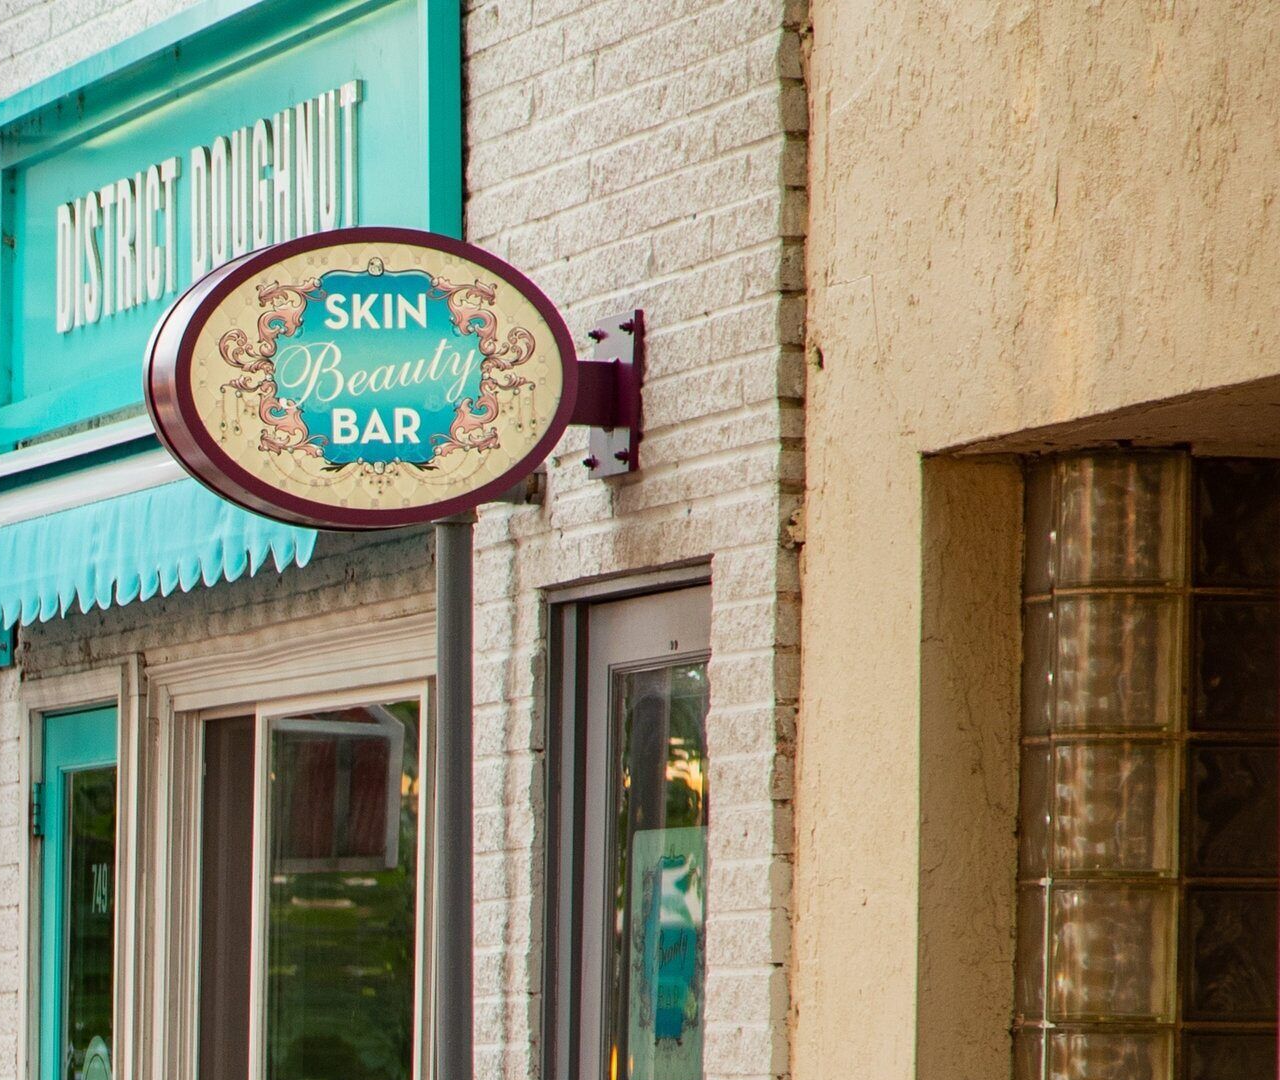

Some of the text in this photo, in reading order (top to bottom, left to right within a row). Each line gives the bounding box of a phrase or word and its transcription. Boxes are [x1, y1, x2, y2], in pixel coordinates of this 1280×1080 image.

[56, 79, 363, 333] DISTRICT DOUGHNUT
[324, 293, 427, 329] SKIN
[275, 339, 480, 408] Beauty
[333, 408, 421, 444] BAR
[91, 862, 108, 914] 749
